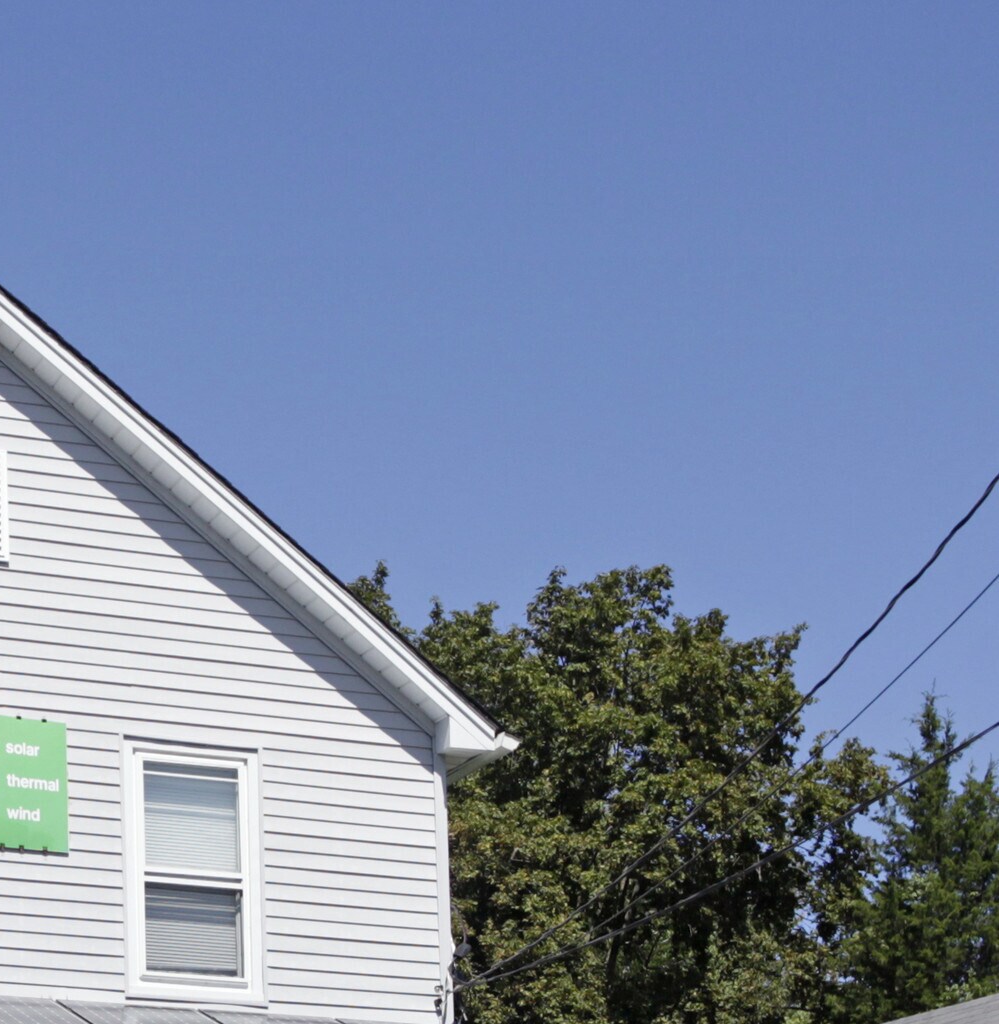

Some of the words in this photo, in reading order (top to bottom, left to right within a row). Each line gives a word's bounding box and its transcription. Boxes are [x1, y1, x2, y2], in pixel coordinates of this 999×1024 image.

[5, 741, 40, 757] solar
[6, 773, 60, 792] thermal
[6, 806, 41, 822] wind
